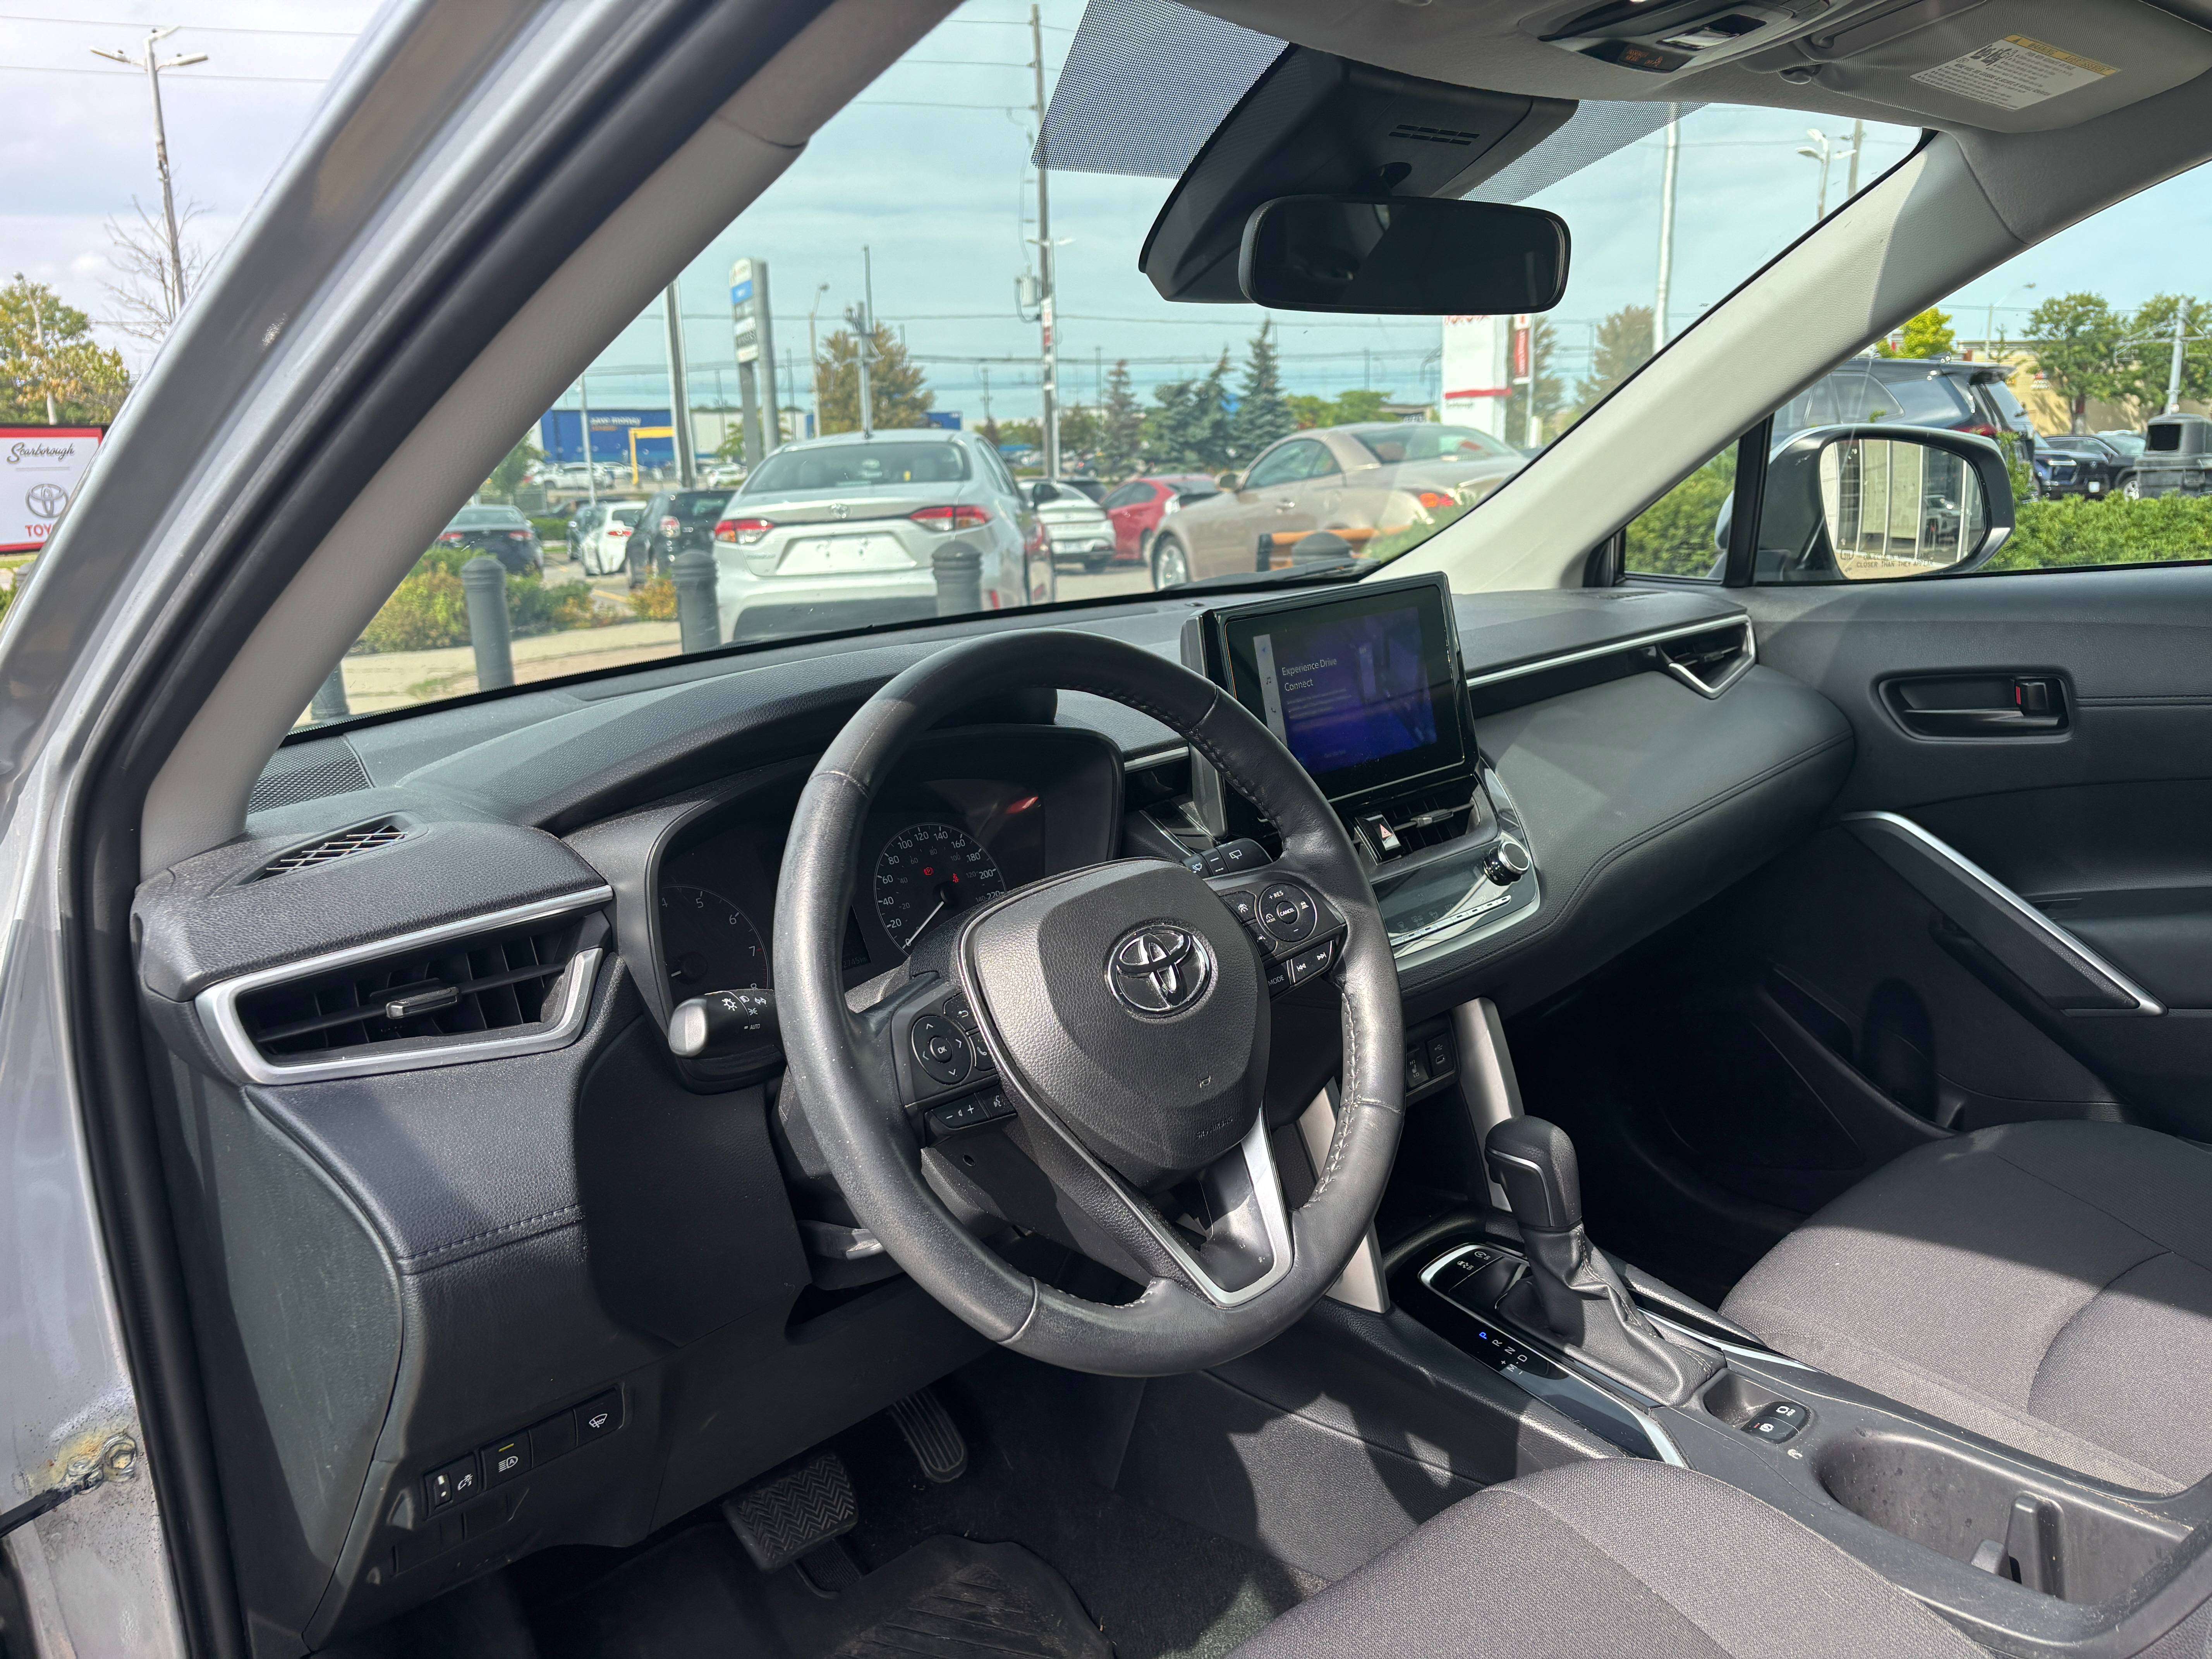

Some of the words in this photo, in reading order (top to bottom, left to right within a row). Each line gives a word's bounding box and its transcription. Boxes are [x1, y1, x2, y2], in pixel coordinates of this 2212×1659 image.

[7, 442, 75, 464] Scarborough
[25, 523, 53, 538] TOY
[1282, 662, 1319, 676] Experience
[1320, 658, 1337, 668] Drive
[1285, 678, 1314, 691] Connect
[914, 831, 929, 842] 120
[934, 831, 948, 841] 140
[898, 839, 913, 849] 100
[951, 839, 965, 849] 160
[888, 856, 900, 865] 80
[967, 852, 981, 862] 180
[882, 875, 893, 884] 60
[979, 869, 994, 880] 200
[883, 896, 894, 905] 40
[987, 891, 1001, 900] 220
[696, 898, 704, 908] 5
[1279, 908, 1295, 916] CANCEL
[729, 914, 737, 924] 6
[891, 918, 902, 928] 20
[749, 946, 755, 957] 7
[1268, 975, 1285, 986] MODE
[1504, 1346, 1516, 1355] N
[1517, 1354, 1528, 1362] D
[1506, 1364, 1518, 1372] M
